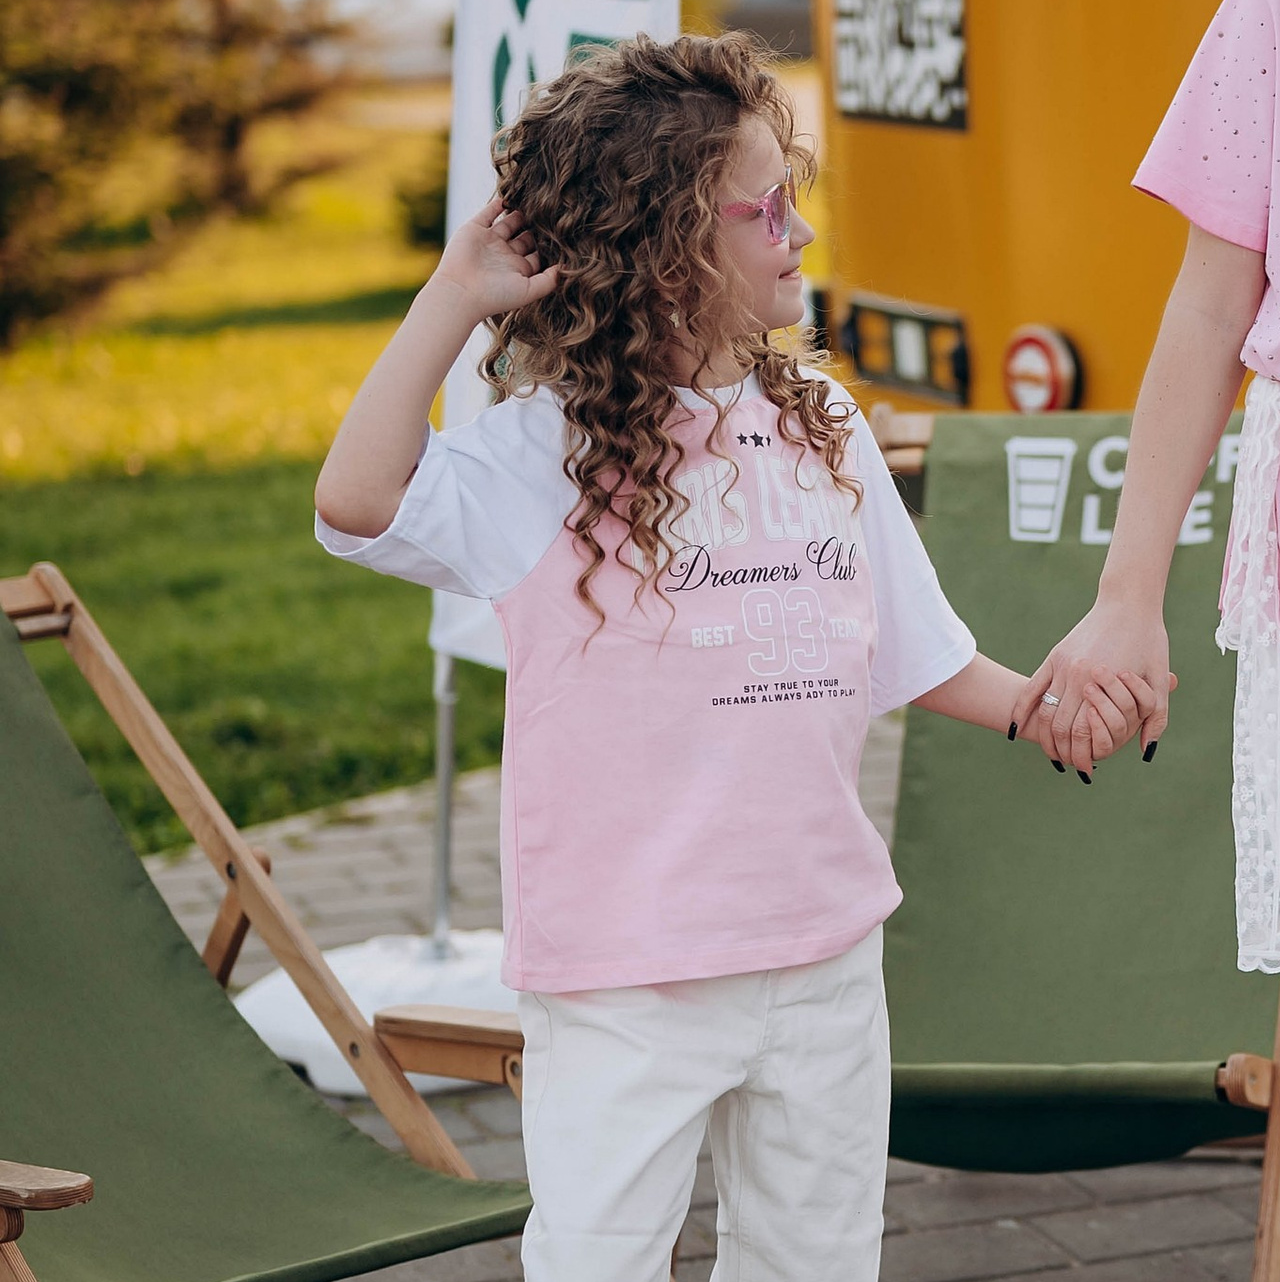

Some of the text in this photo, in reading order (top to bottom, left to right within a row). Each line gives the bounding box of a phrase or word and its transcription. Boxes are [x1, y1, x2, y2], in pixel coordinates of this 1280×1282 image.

[1080, 490, 1214, 545] LE
[664, 536, 857, 593] Dreamers Club
[691, 625, 735, 648] BEST
[741, 587, 828, 677] 93
[712, 695, 757, 706] DREAMS
[761, 692, 802, 703] ALWAYS
[828, 689, 838, 697] TO
[840, 688, 856, 697] PLAY
[743, 678, 839, 694] STAY TRUE TO YOUR
